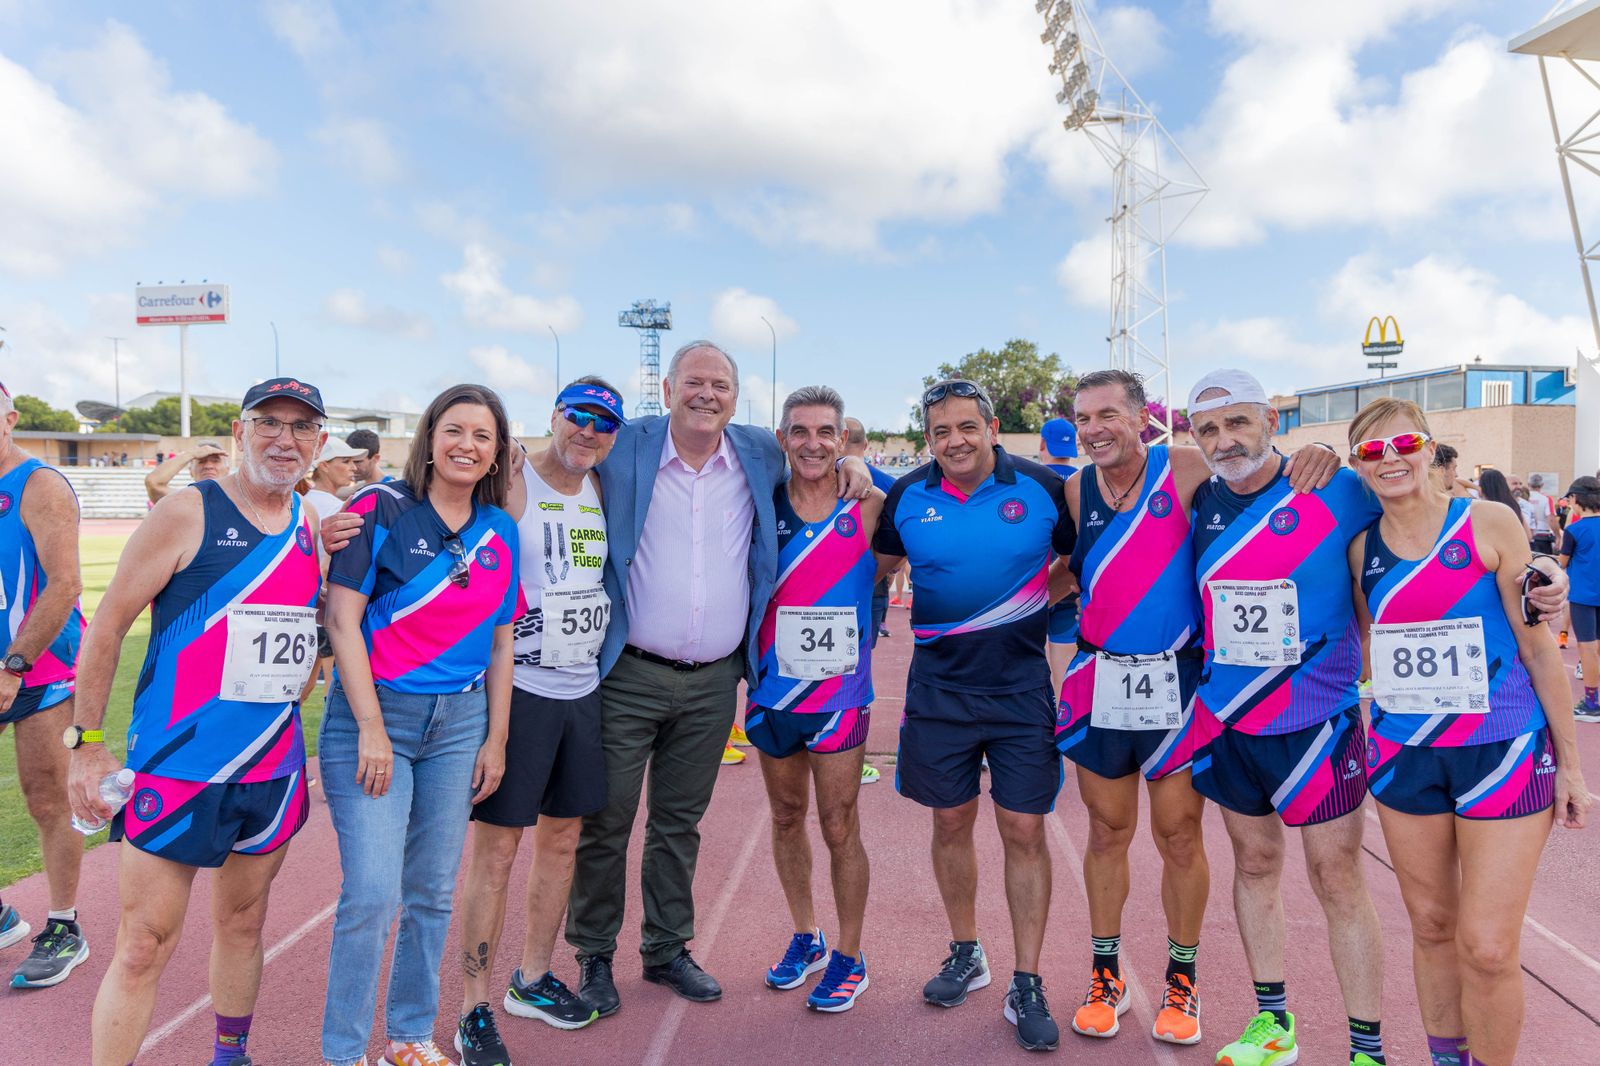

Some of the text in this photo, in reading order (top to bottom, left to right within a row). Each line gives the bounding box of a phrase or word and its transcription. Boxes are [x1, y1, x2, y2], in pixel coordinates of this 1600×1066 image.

[138, 294, 196, 307] Carrefour
[920, 515, 943, 523] VIATOR
[570, 528, 605, 541] CARROS
[409, 547, 435, 558] VIATOR
[571, 542, 585, 553] DE
[573, 556, 602, 568] FUEGO
[561, 605, 603, 635] 530
[1233, 604, 1268, 633] 32
[252, 631, 306, 665] 126
[800, 627, 835, 652] 34
[1393, 645, 1459, 678] 881
[1122, 672, 1154, 699] 14
